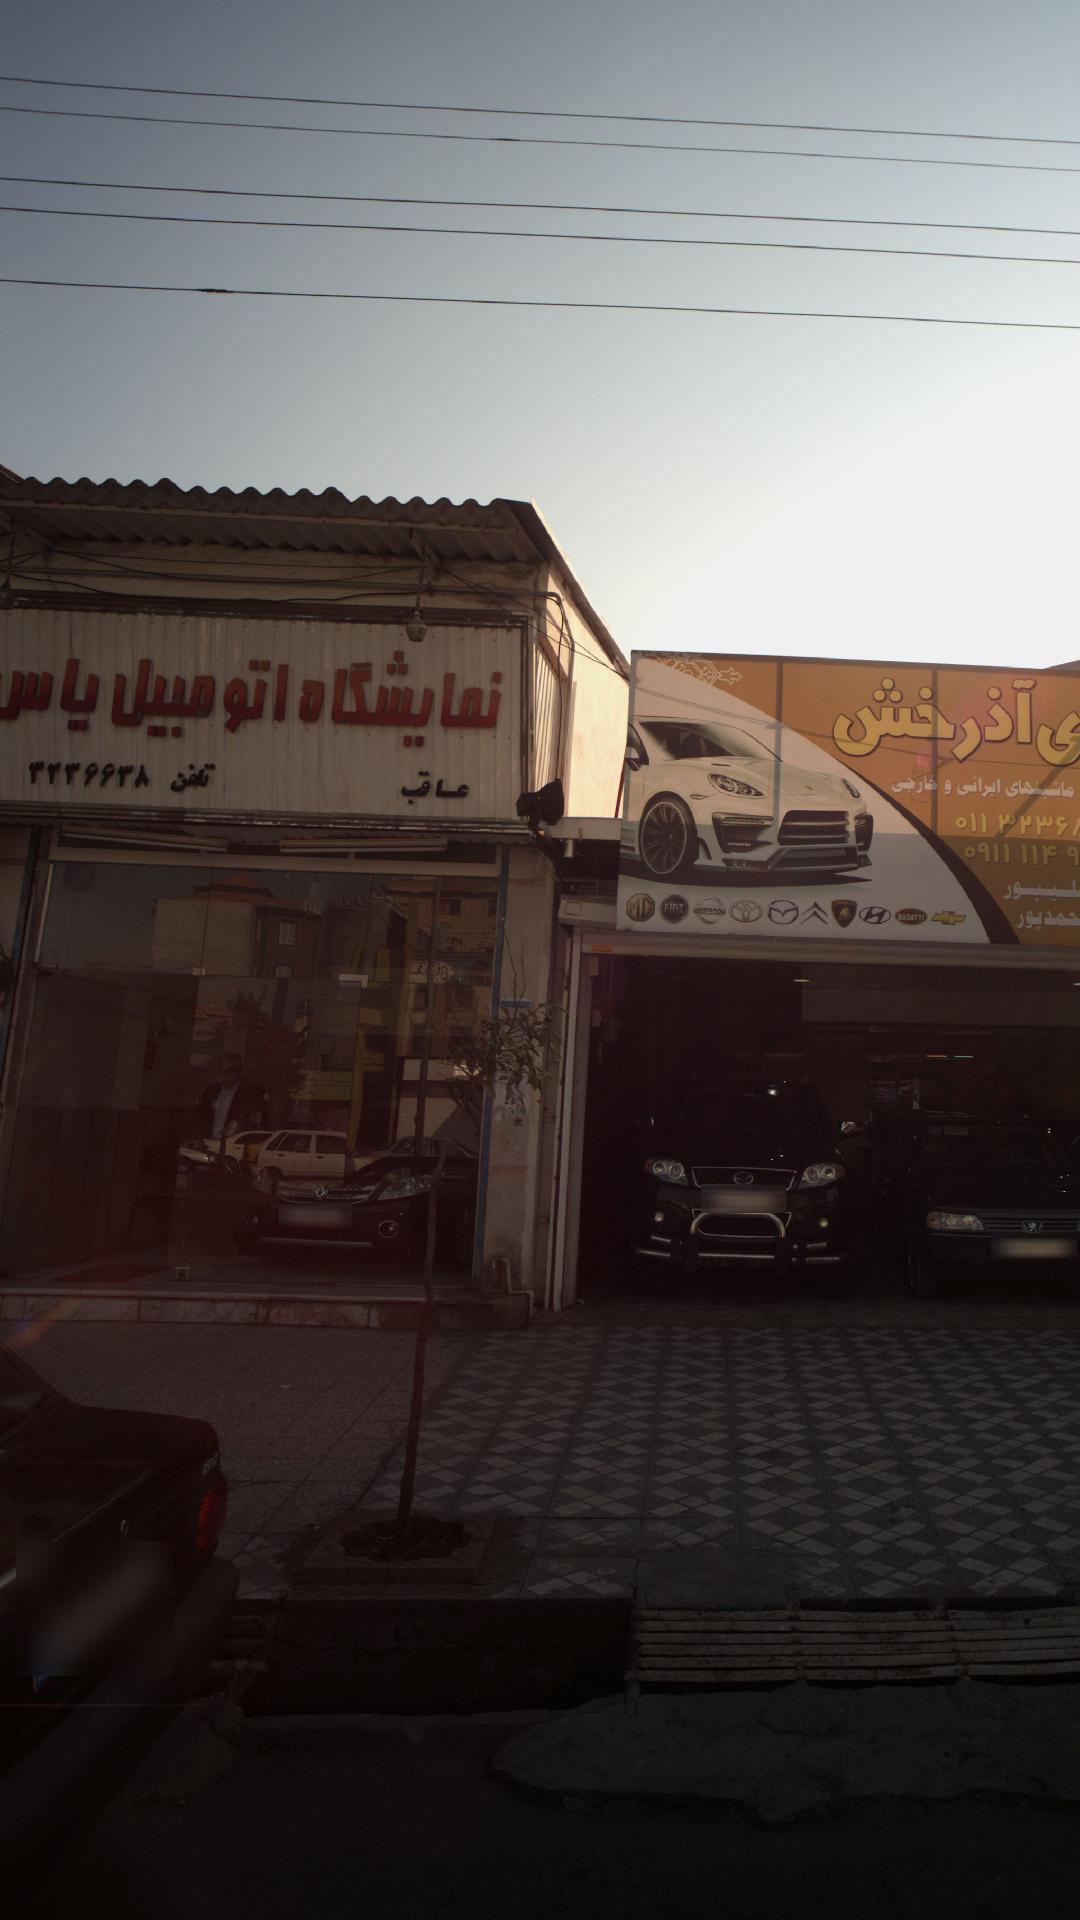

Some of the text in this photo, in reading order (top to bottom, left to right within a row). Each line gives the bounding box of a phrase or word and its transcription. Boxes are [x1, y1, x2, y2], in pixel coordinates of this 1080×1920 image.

[111, 658, 290, 738] اتومبیل
[299, 650, 503, 747] نمایشگاه
[833, 677, 1037, 763] آذرخش
[170, 763, 217, 793] تلفن
[891, 775, 938, 795] خارجی
[943, 778, 953, 796] و
[957, 776, 1001, 798] ایرانی
[955, 812, 988, 834] ۰۱۱
[964, 842, 1011, 864] ۰۹۱۱
[1022, 845, 1058, 866] ۱۱۴
[663, 902, 685, 914] FIAT
